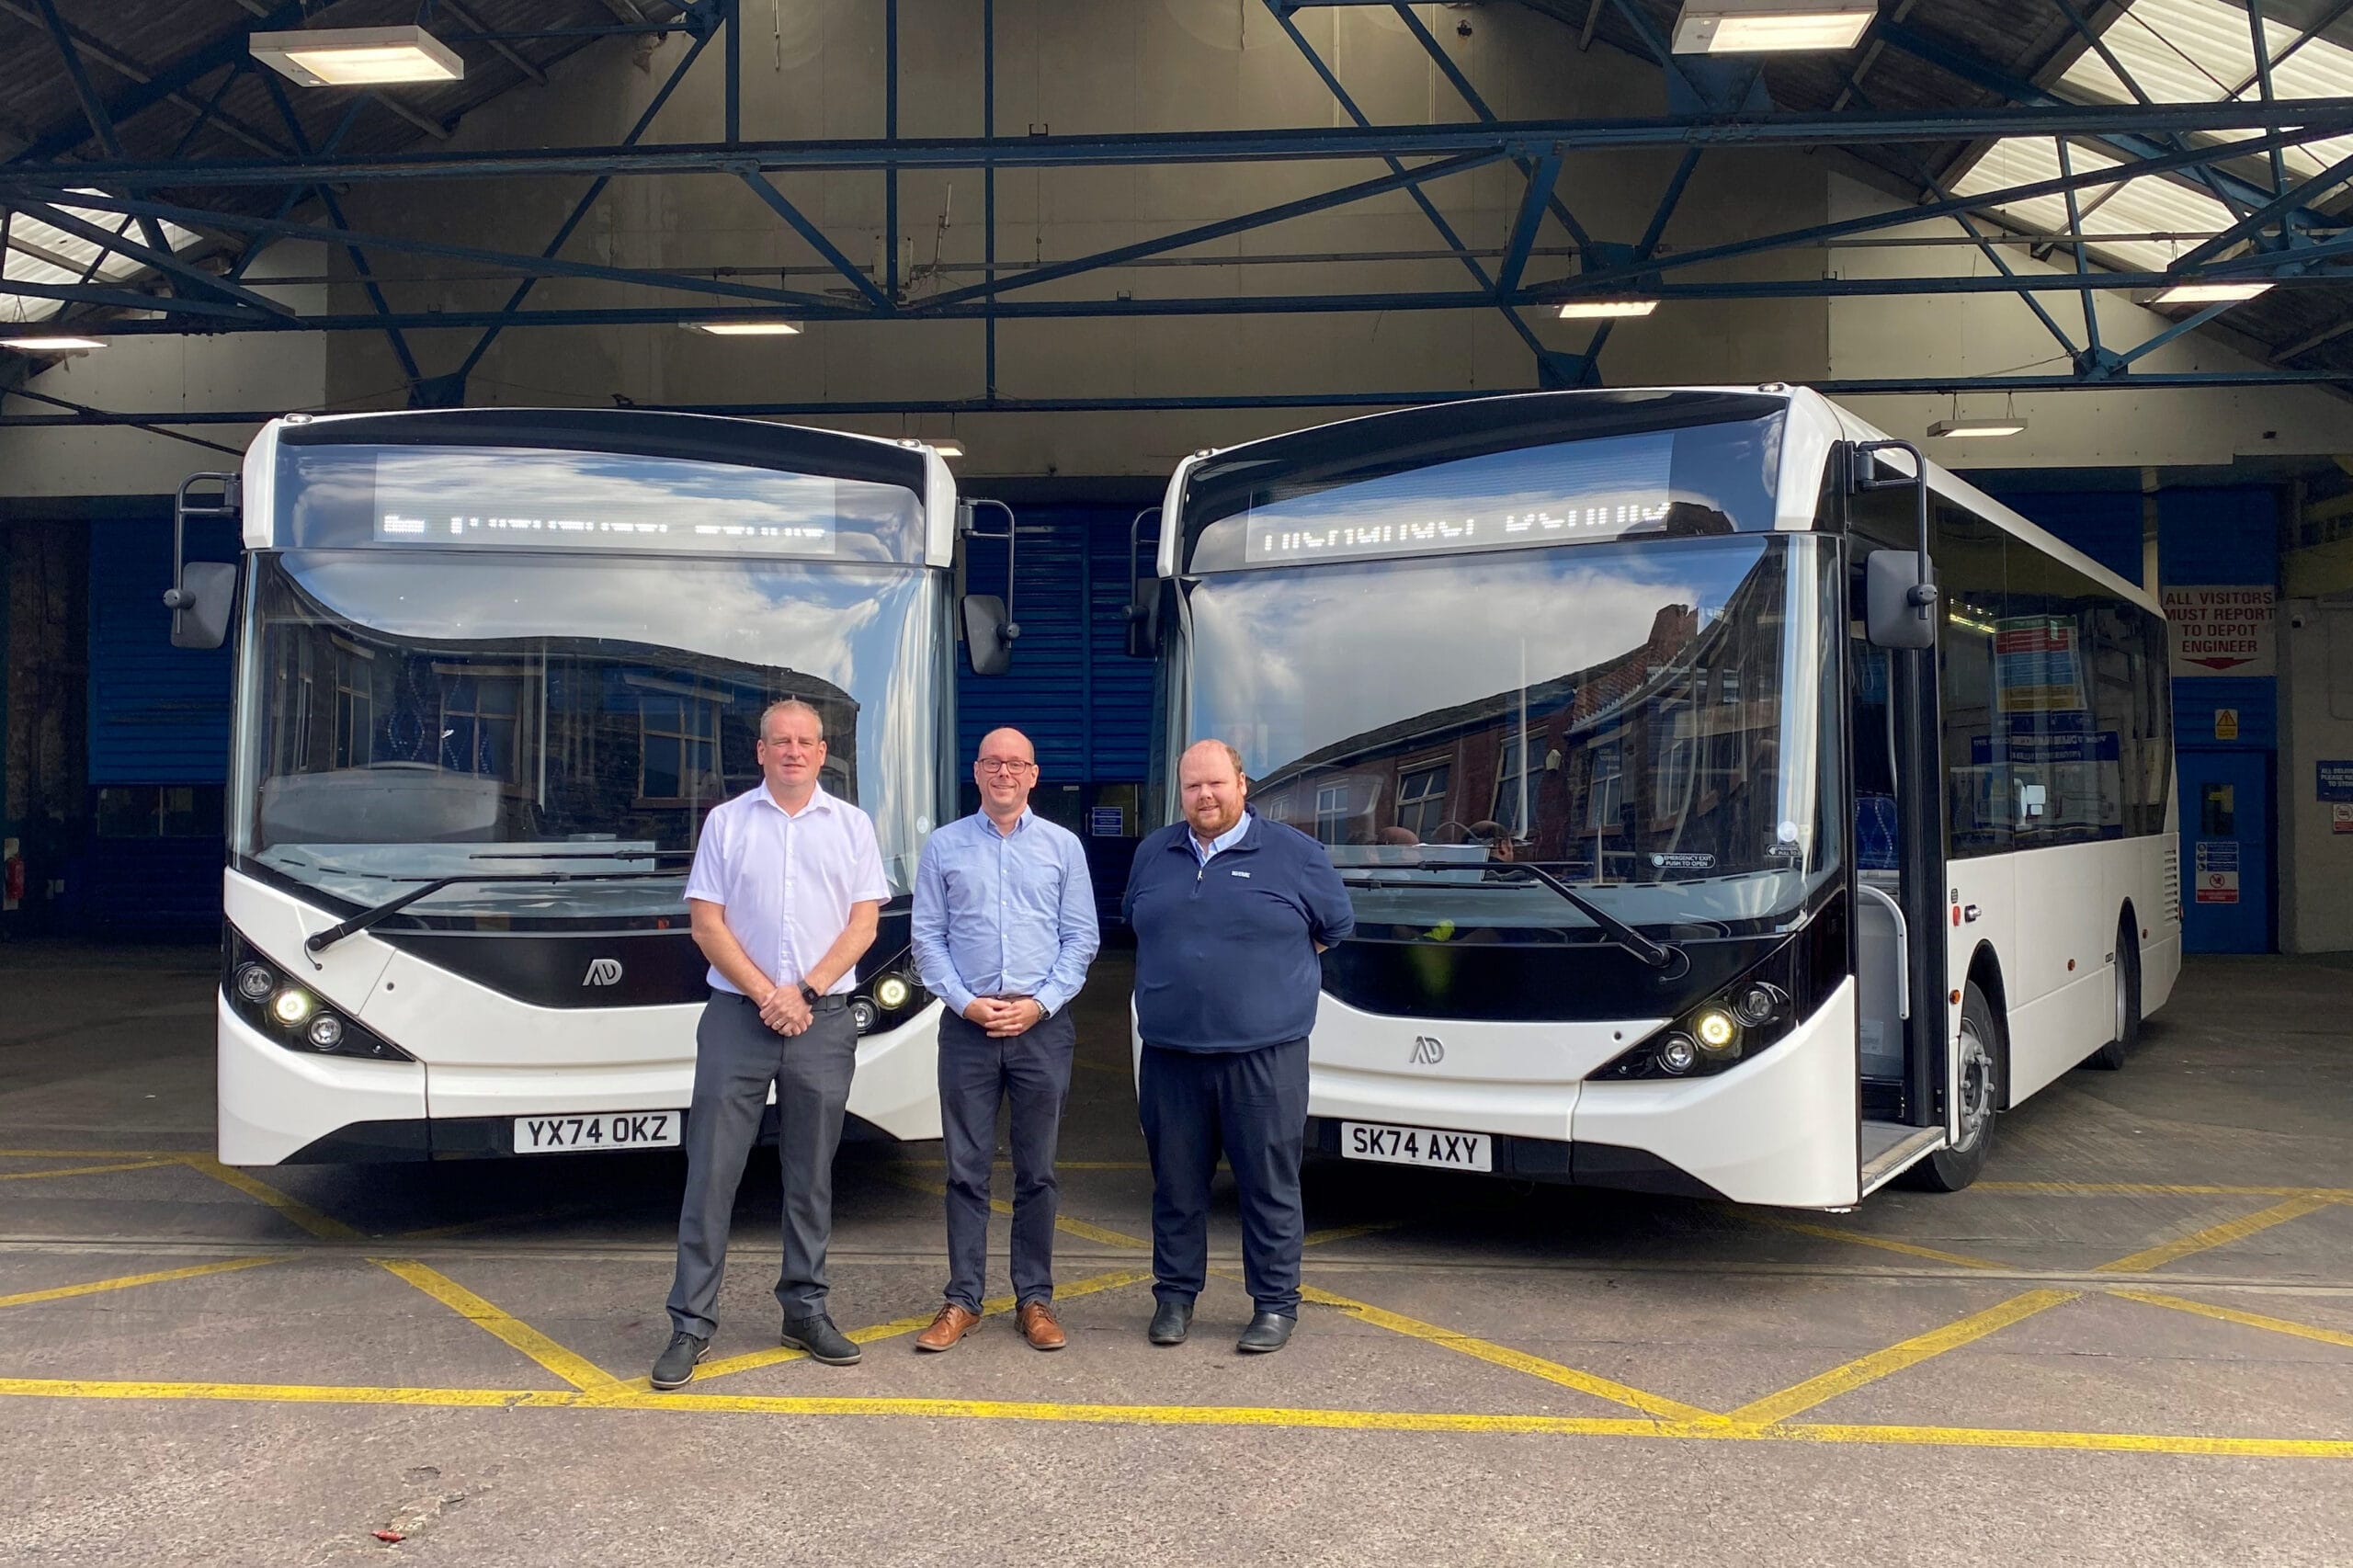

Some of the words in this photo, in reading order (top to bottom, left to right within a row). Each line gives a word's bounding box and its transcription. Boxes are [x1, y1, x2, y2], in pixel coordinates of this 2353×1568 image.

[2165, 593, 2193, 605] ALL
[2199, 592, 2272, 605] VISITORS
[2164, 608, 2208, 621] MUST
[2214, 608, 2277, 620] REPORT
[2181, 624, 2201, 637] TO
[2207, 624, 2258, 637] DEPOT
[2182, 640, 2257, 653] ENGINEER
[528, 1117, 603, 1146] YX74
[612, 1115, 668, 1142] OKZ
[1353, 1127, 1419, 1158] SK74
[1427, 1133, 1478, 1165] AXY
